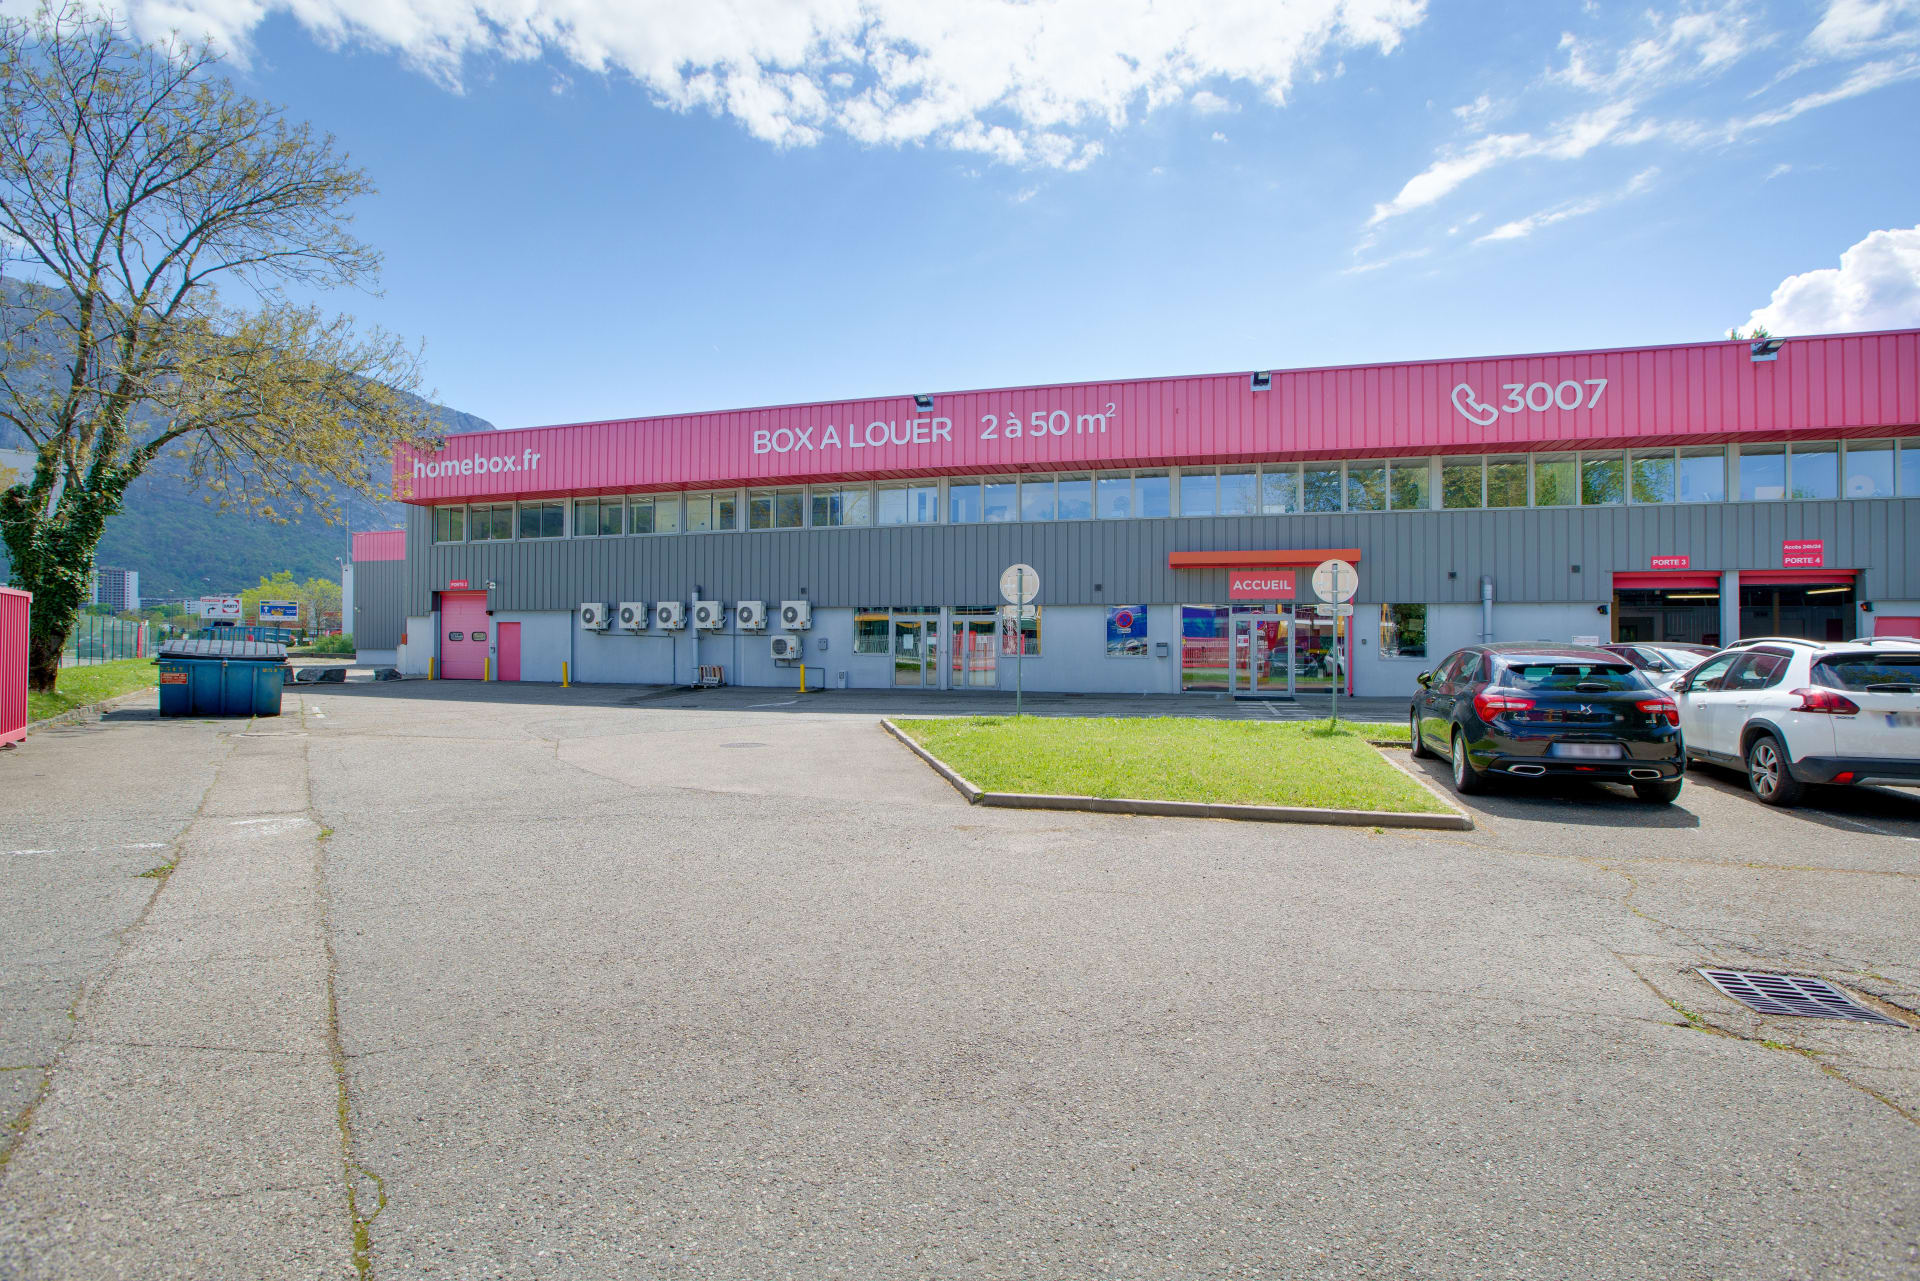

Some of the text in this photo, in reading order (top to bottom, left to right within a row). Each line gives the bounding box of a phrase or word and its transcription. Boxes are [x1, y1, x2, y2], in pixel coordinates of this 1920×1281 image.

[1501, 378, 1608, 413] 3007
[753, 418, 953, 455] BOX A LOUER
[980, 414, 999, 440] 2
[1005, 411, 1022, 439] à
[1029, 409, 1071, 437] 50
[412, 448, 541, 480] homebox.fr
[1233, 580, 1293, 590] ACCUEIL
